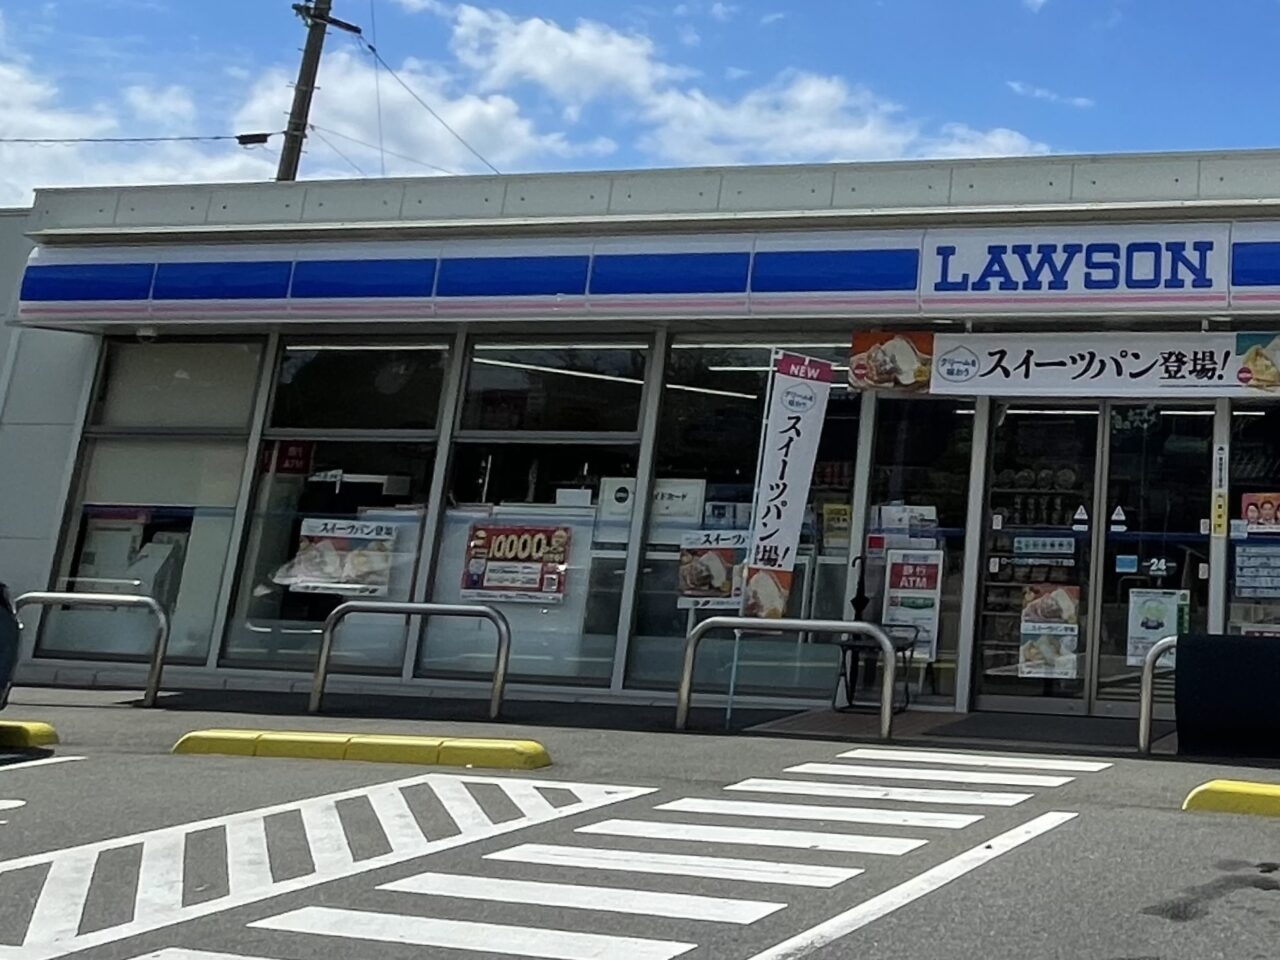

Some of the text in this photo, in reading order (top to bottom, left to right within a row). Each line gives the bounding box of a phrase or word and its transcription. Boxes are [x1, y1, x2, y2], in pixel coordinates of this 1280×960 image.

[934, 241, 1214, 292] LAWSON
[789, 364, 821, 379] NEW
[979, 349, 1231, 381] スイーツパン登場!
[1150, 558, 1167, 571] 24
[899, 576, 928, 589] ATM
